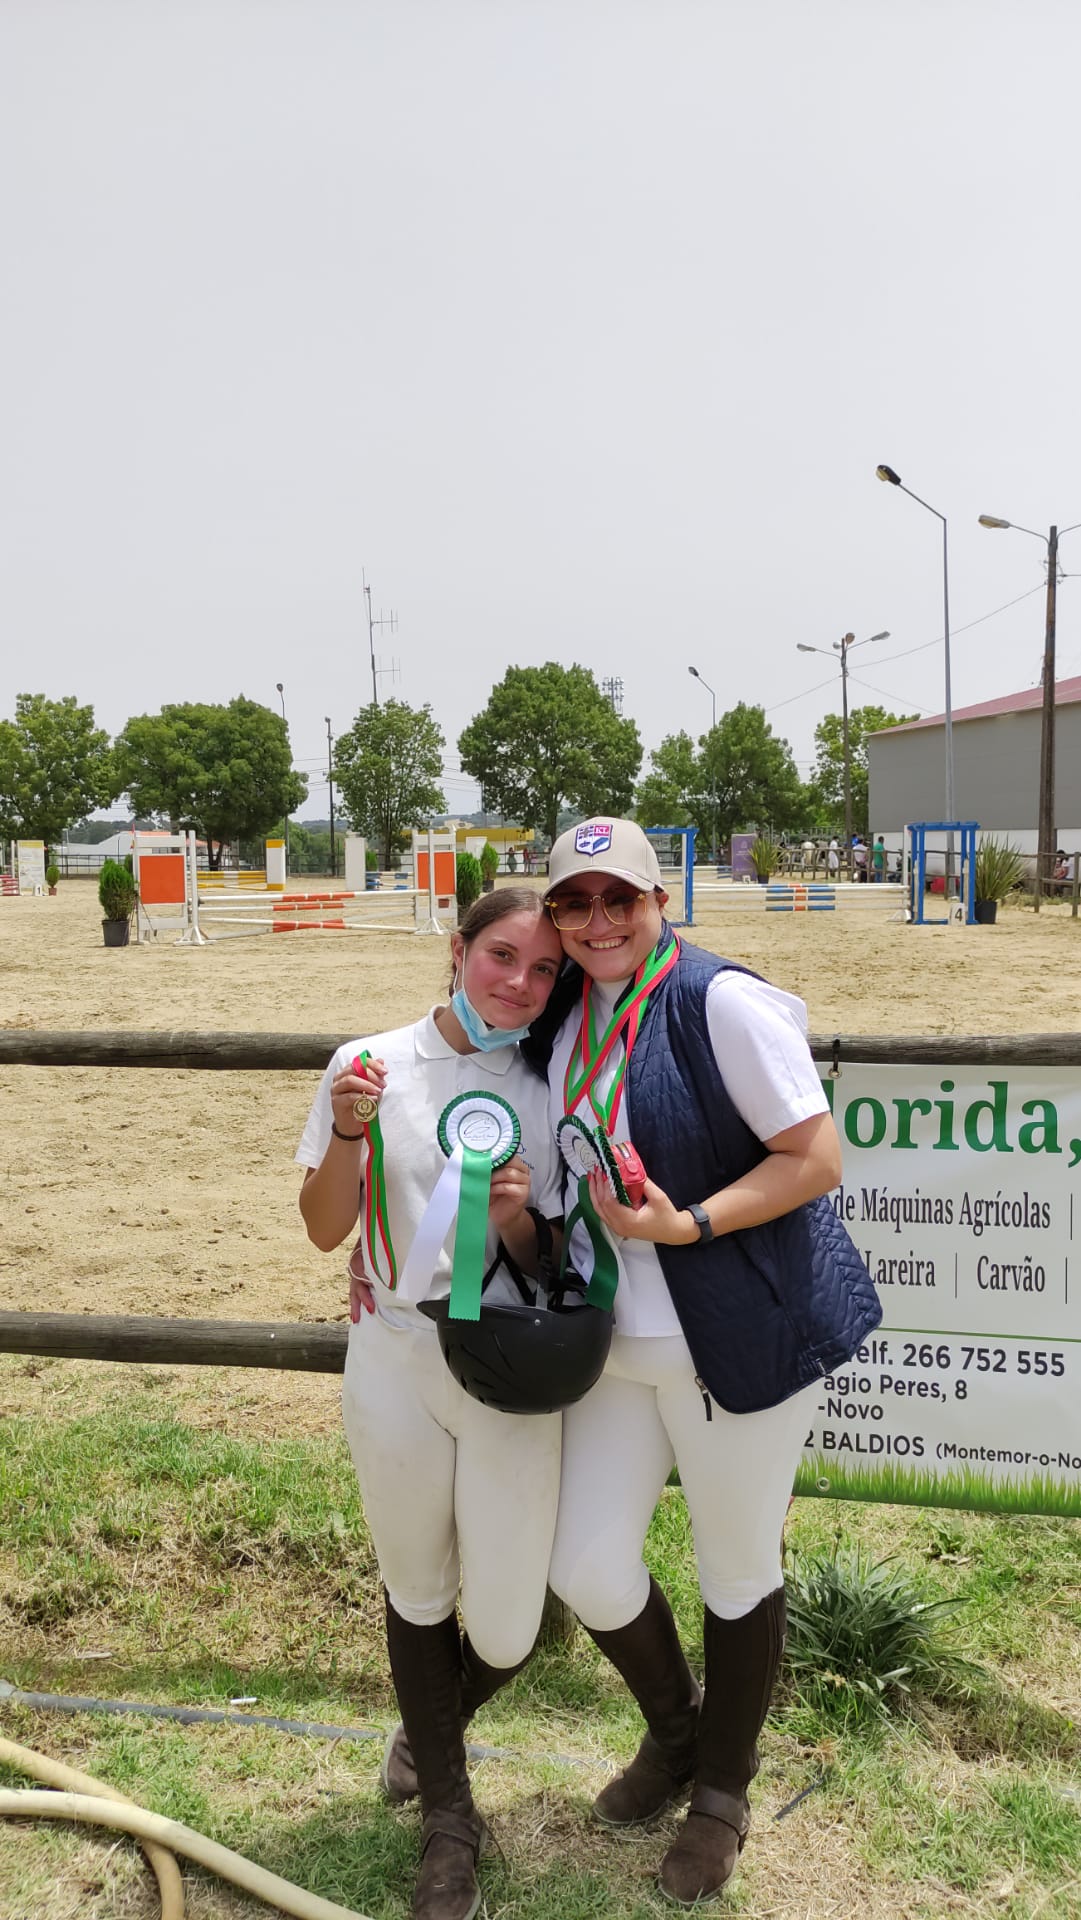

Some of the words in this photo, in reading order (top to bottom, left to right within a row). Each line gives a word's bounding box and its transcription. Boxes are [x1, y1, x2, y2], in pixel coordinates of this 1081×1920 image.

[955, 908, 962, 922] 4
[834, 1185, 855, 1221] de
[861, 1187, 954, 1233] Máquinas
[959, 1190, 1050, 1237] Agrícolas
[865, 1250, 936, 1287] Lareira
[977, 1255, 1045, 1292] Carvão
[903, 1343, 951, 1369] 266
[961, 1346, 1006, 1373] 752
[1017, 1350, 1065, 1377] 555
[880, 1374, 946, 1403] Peres,
[955, 1379, 967, 1400] 8
[823, 1430, 925, 1457] BALDIOS
